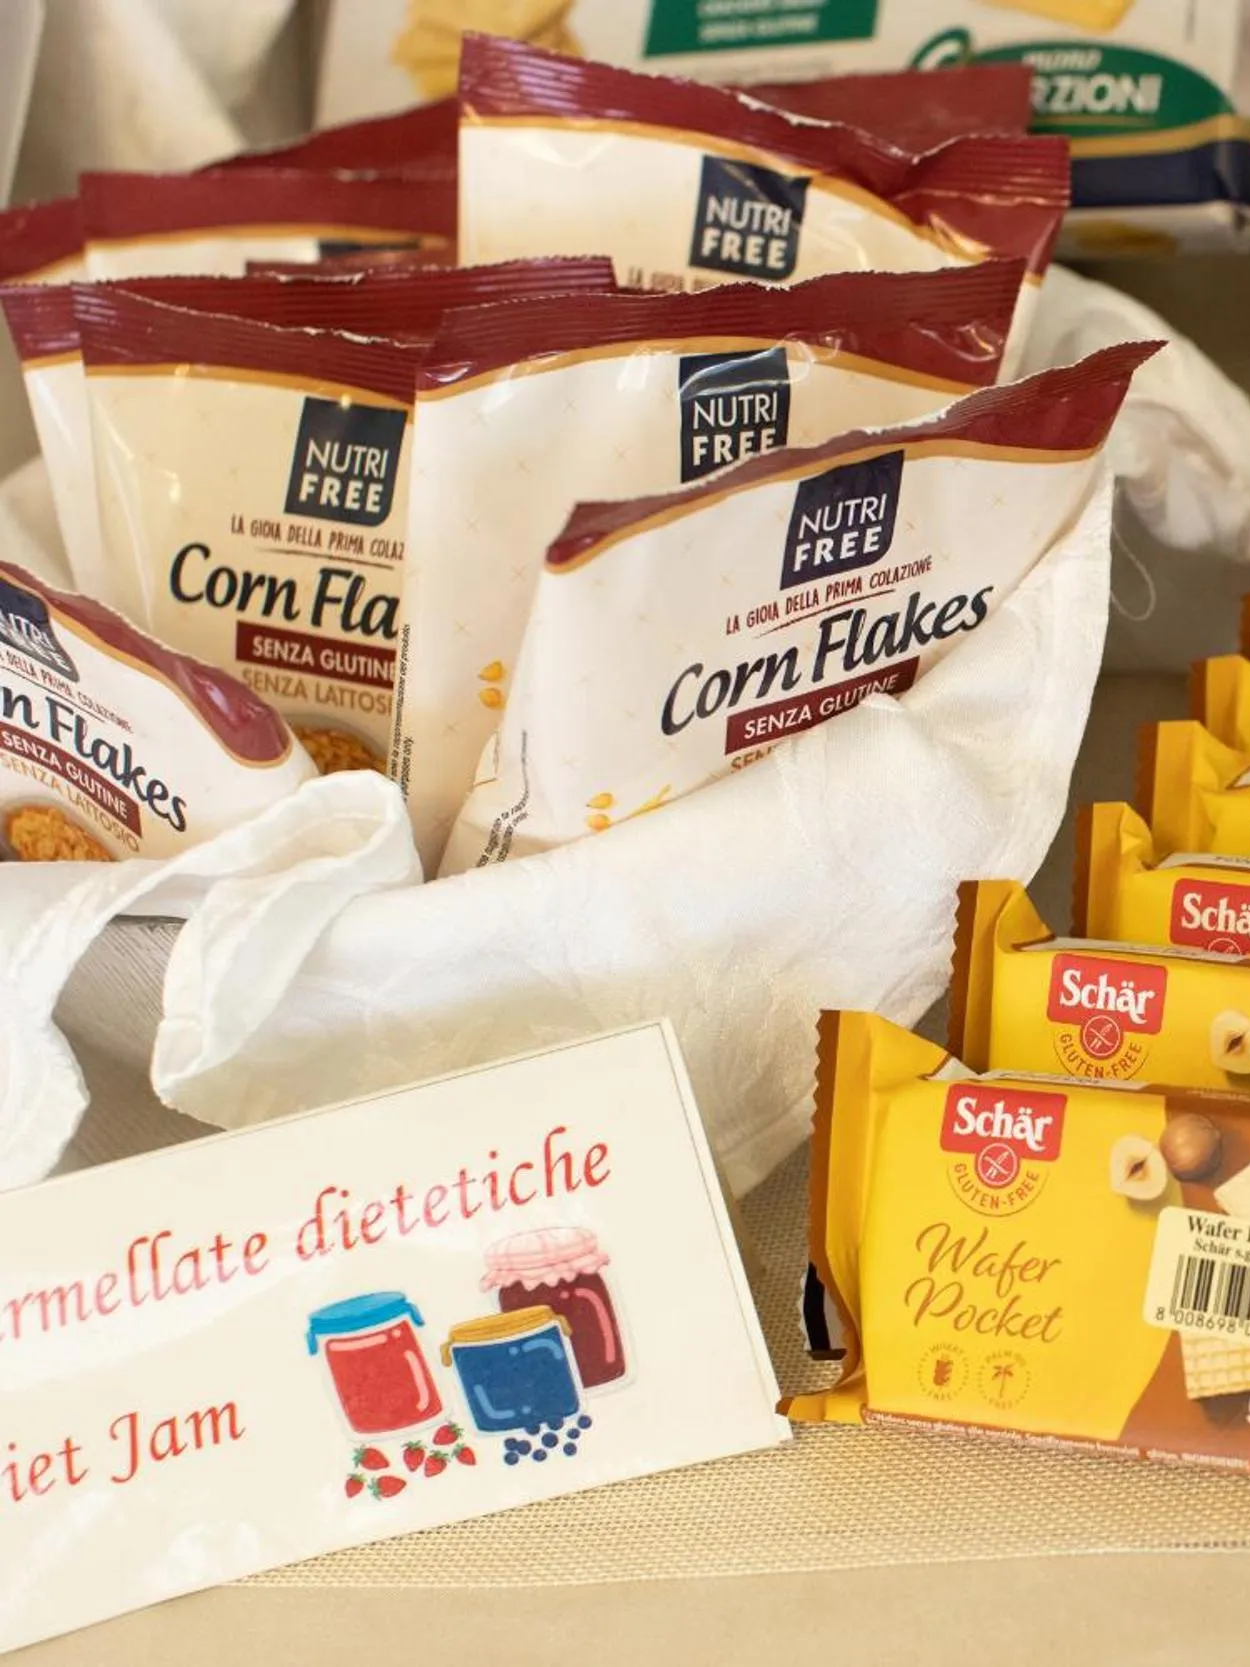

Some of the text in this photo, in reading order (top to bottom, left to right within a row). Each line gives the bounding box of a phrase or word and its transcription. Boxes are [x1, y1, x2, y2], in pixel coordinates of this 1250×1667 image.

[1030, 73, 1163, 113] RZIONI
[706, 197, 791, 236] NUTRI
[702, 227, 788, 269] FREE
[693, 391, 777, 429] NUTRI
[306, 439, 388, 478] NUTRI
[692, 428, 776, 466] FREE
[300, 473, 384, 513] FREE
[797, 493, 887, 539] NUTRI
[231, 514, 405, 561] LA GIOIA DELLA PRIMA COLAZ
[792, 526, 882, 572] FREE
[170, 543, 400, 640] Corn Fla
[726, 555, 933, 635] LA GIOIA DELLA PRIMA COLAZIONE
[253, 635, 315, 667] SENZA
[660, 585, 994, 736] Corn Flakes
[243, 667, 393, 716] SENZA LATTOSI
[744, 673, 901, 739] SENZA GLUTINE
[2, 731, 129, 820] SENZA GLUTINE
[45, 696, 187, 832] Flakes
[61, 782, 140, 852] LATTOSIO
[1059, 968, 1155, 1025] Schär
[1059, 1032, 1142, 1079] GLUTEN-FREE
[953, 1096, 1053, 1152] Schär
[954, 1162, 1040, 1209] GLUTEN-FREE
[0, 1125, 612, 1343] rmellate dietetiche
[1187, 1215, 1243, 1241] Wafer
[1193, 1238, 1231, 1258] Schär
[915, 1222, 1061, 1298] Wafer
[904, 1277, 1064, 1344] Pocket
[1155, 1306, 1165, 1321] 8
[1174, 1309, 1237, 1334] 008698
[1, 1401, 245, 1502] iet Jam
